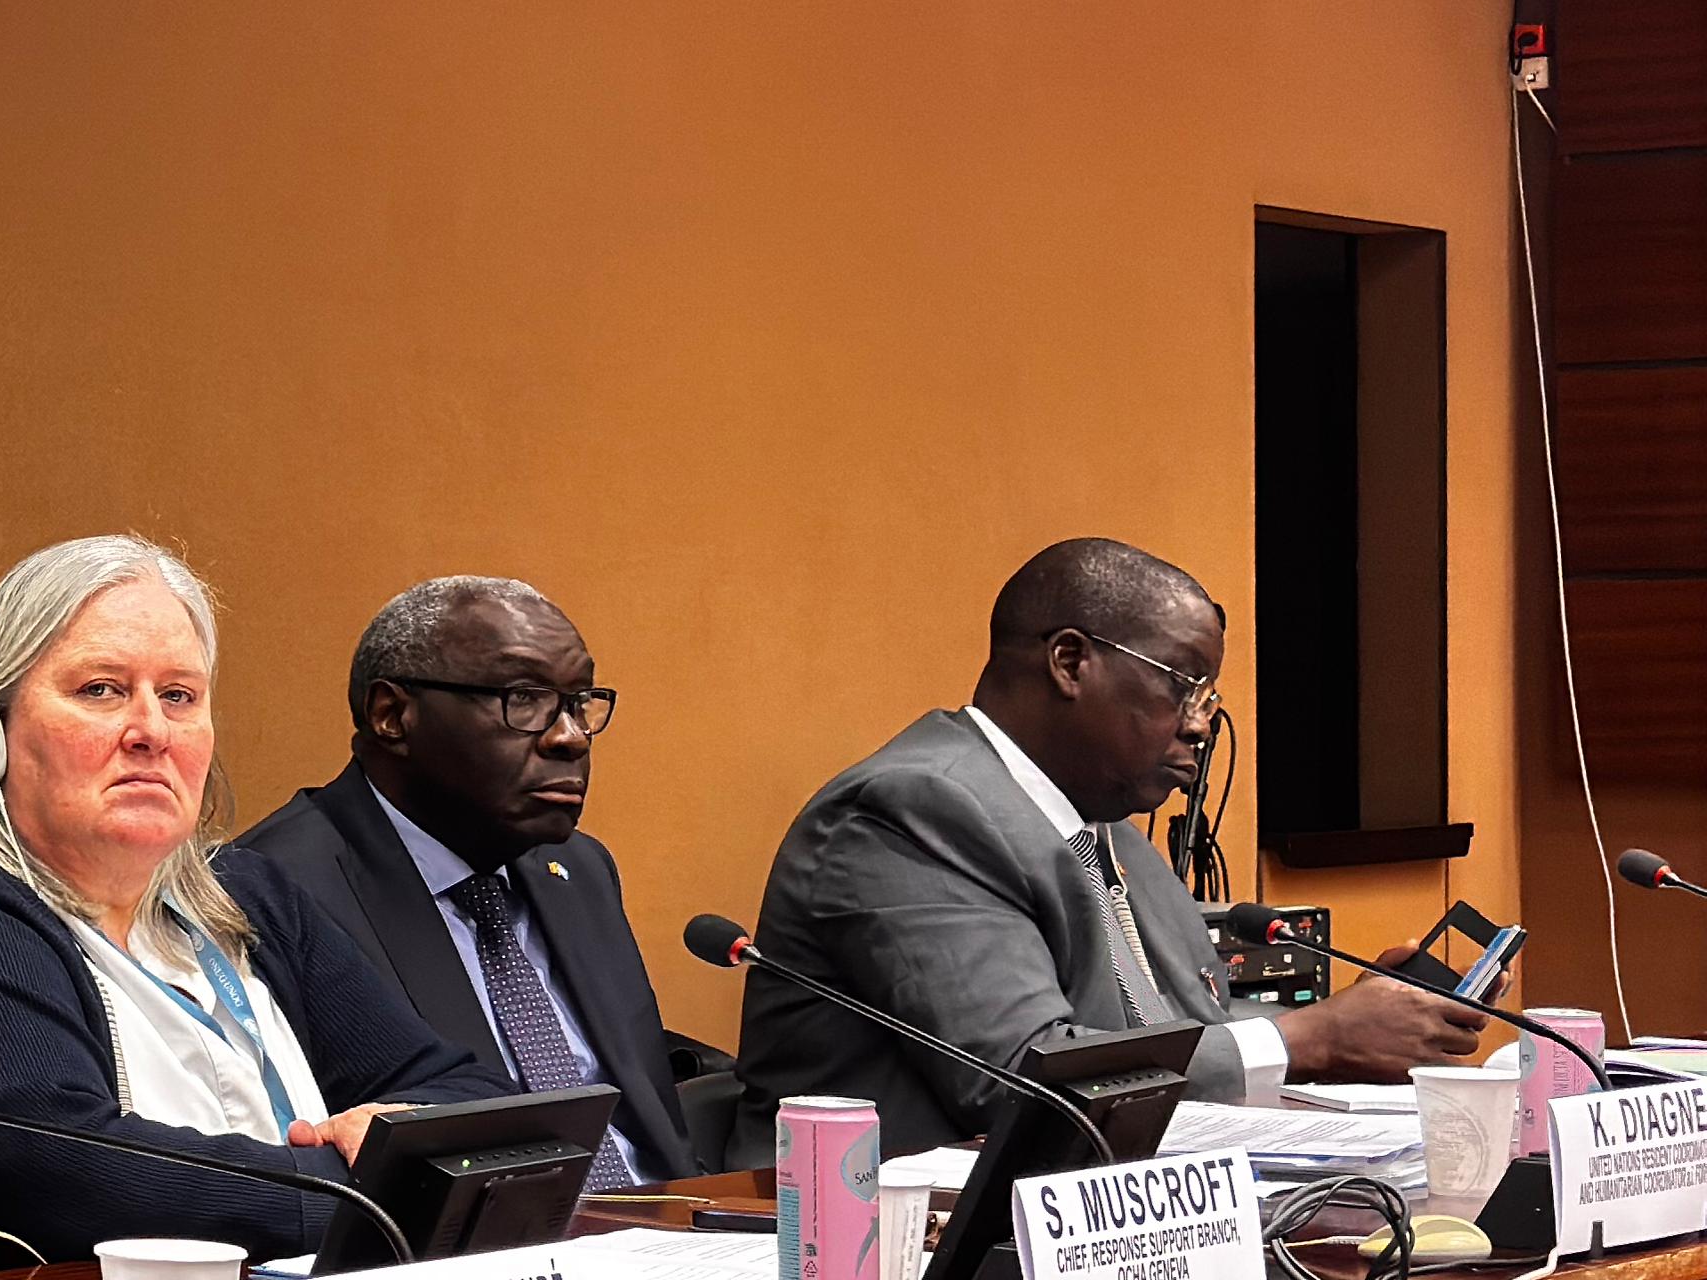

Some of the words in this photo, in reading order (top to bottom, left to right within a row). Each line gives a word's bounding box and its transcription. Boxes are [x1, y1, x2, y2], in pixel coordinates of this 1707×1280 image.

[1587, 1101, 1616, 1148] K.
[1618, 1088, 1707, 1143] DIAGNE
[1589, 1154, 1612, 1178] UNITED
[1613, 1150, 1640, 1174] NATIONS
[1041, 1185, 1074, 1240] S.
[1077, 1157, 1238, 1233] MUSCROFT
[1579, 1181, 1593, 1205] AND
[1056, 1244, 1091, 1273] CHIEF,
[1092, 1233, 1148, 1267] RESPONSE
[1149, 1224, 1195, 1257] SUPPORT
[1196, 1217, 1241, 1248] BRANCH,
